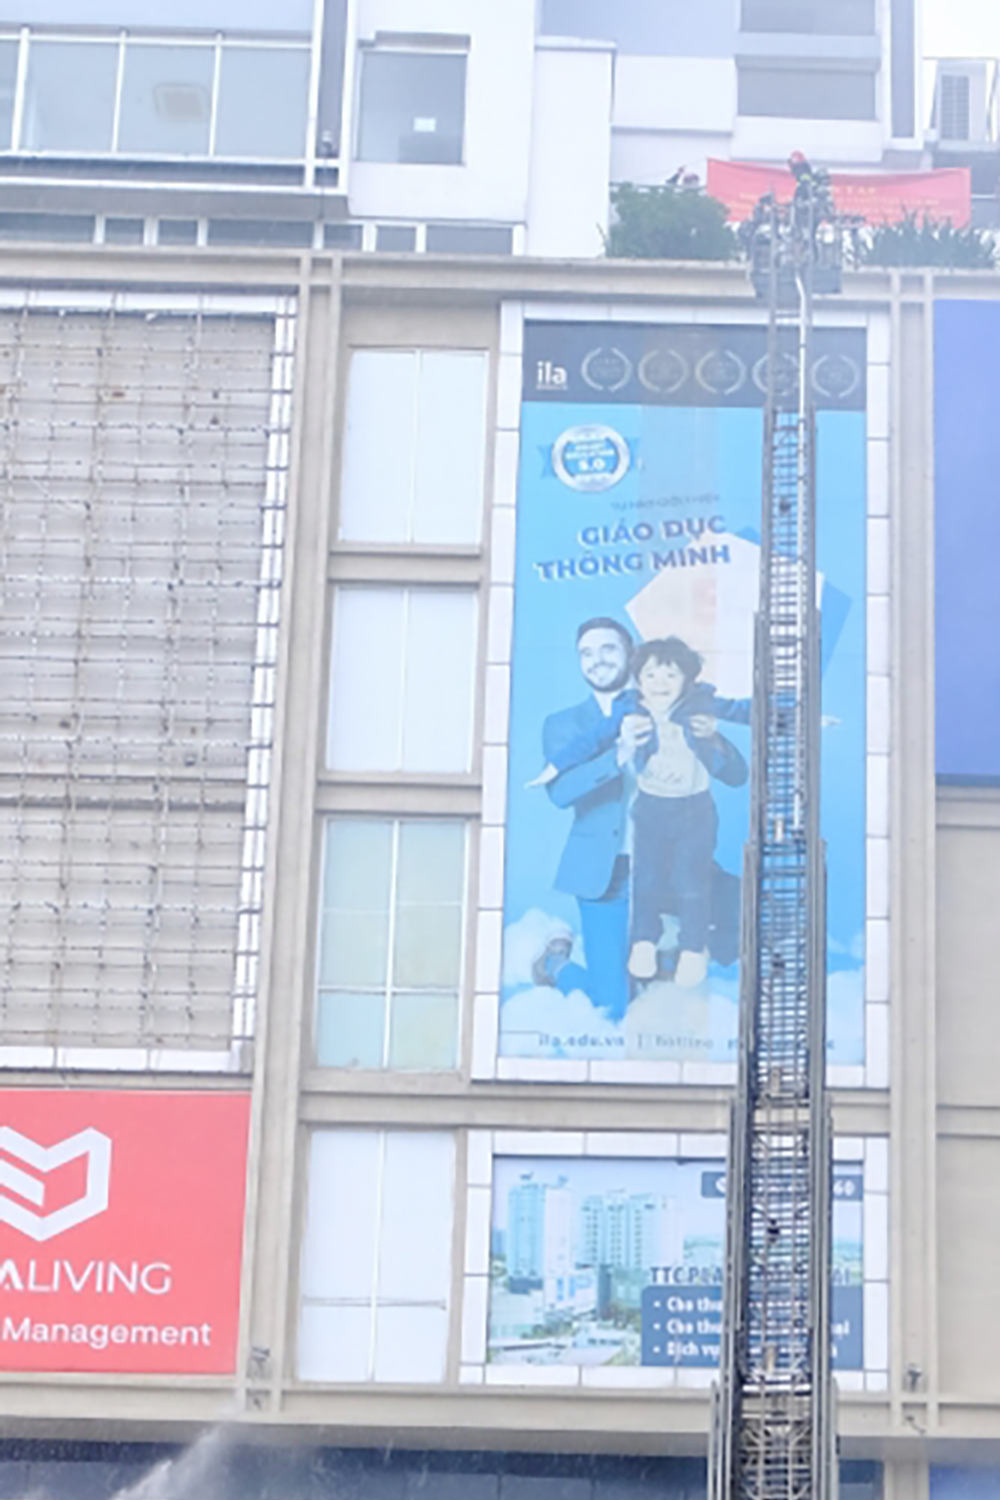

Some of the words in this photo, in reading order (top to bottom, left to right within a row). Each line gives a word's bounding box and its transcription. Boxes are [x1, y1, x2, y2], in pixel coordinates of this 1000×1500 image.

[537, 361, 567, 384] ila
[578, 518, 653, 547] GIÁO
[662, 514, 728, 543] DỤC
[533, 550, 645, 583] THÔNG
[652, 544, 732, 571] MINH
[2, 1317, 212, 1350] Management
